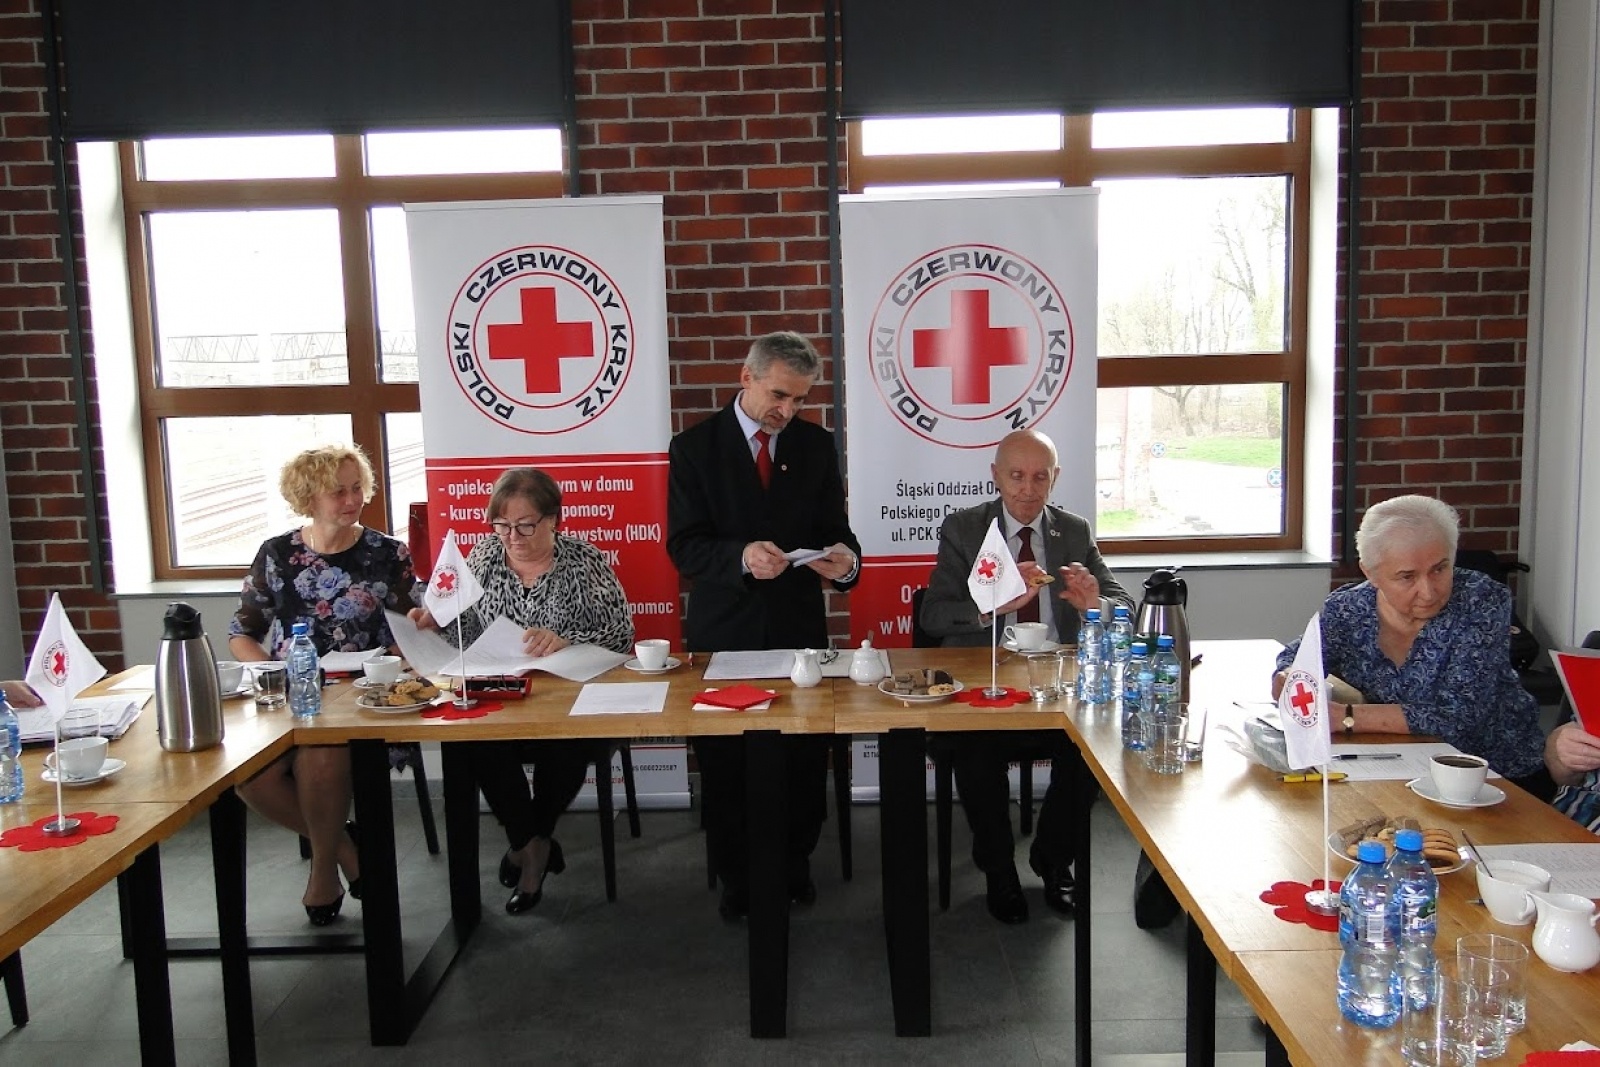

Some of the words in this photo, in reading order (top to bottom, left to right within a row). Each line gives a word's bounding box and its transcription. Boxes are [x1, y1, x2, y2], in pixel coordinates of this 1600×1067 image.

[466, 252, 620, 310] CZERWONY
[892, 251, 1060, 314] CZERWONY
[454, 322, 515, 420] POLSKI
[575, 324, 628, 417] KRZYŻ
[876, 326, 939, 432] POLSKI
[448, 479, 494, 500] opieka
[580, 479, 593, 492] w
[596, 475, 633, 492] domu
[896, 479, 934, 500] Śląski
[937, 481, 983, 496] Oddział
[449, 505, 488, 523] kursy
[561, 504, 614, 522] pomocy
[881, 505, 940, 522] Polskiego
[561, 527, 622, 542] dawstwo
[625, 523, 661, 543] (HDK)
[891, 527, 906, 542] ul.
[909, 526, 933, 541] PCK
[604, 550, 620, 566] DK
[631, 602, 674, 615] pomoc
